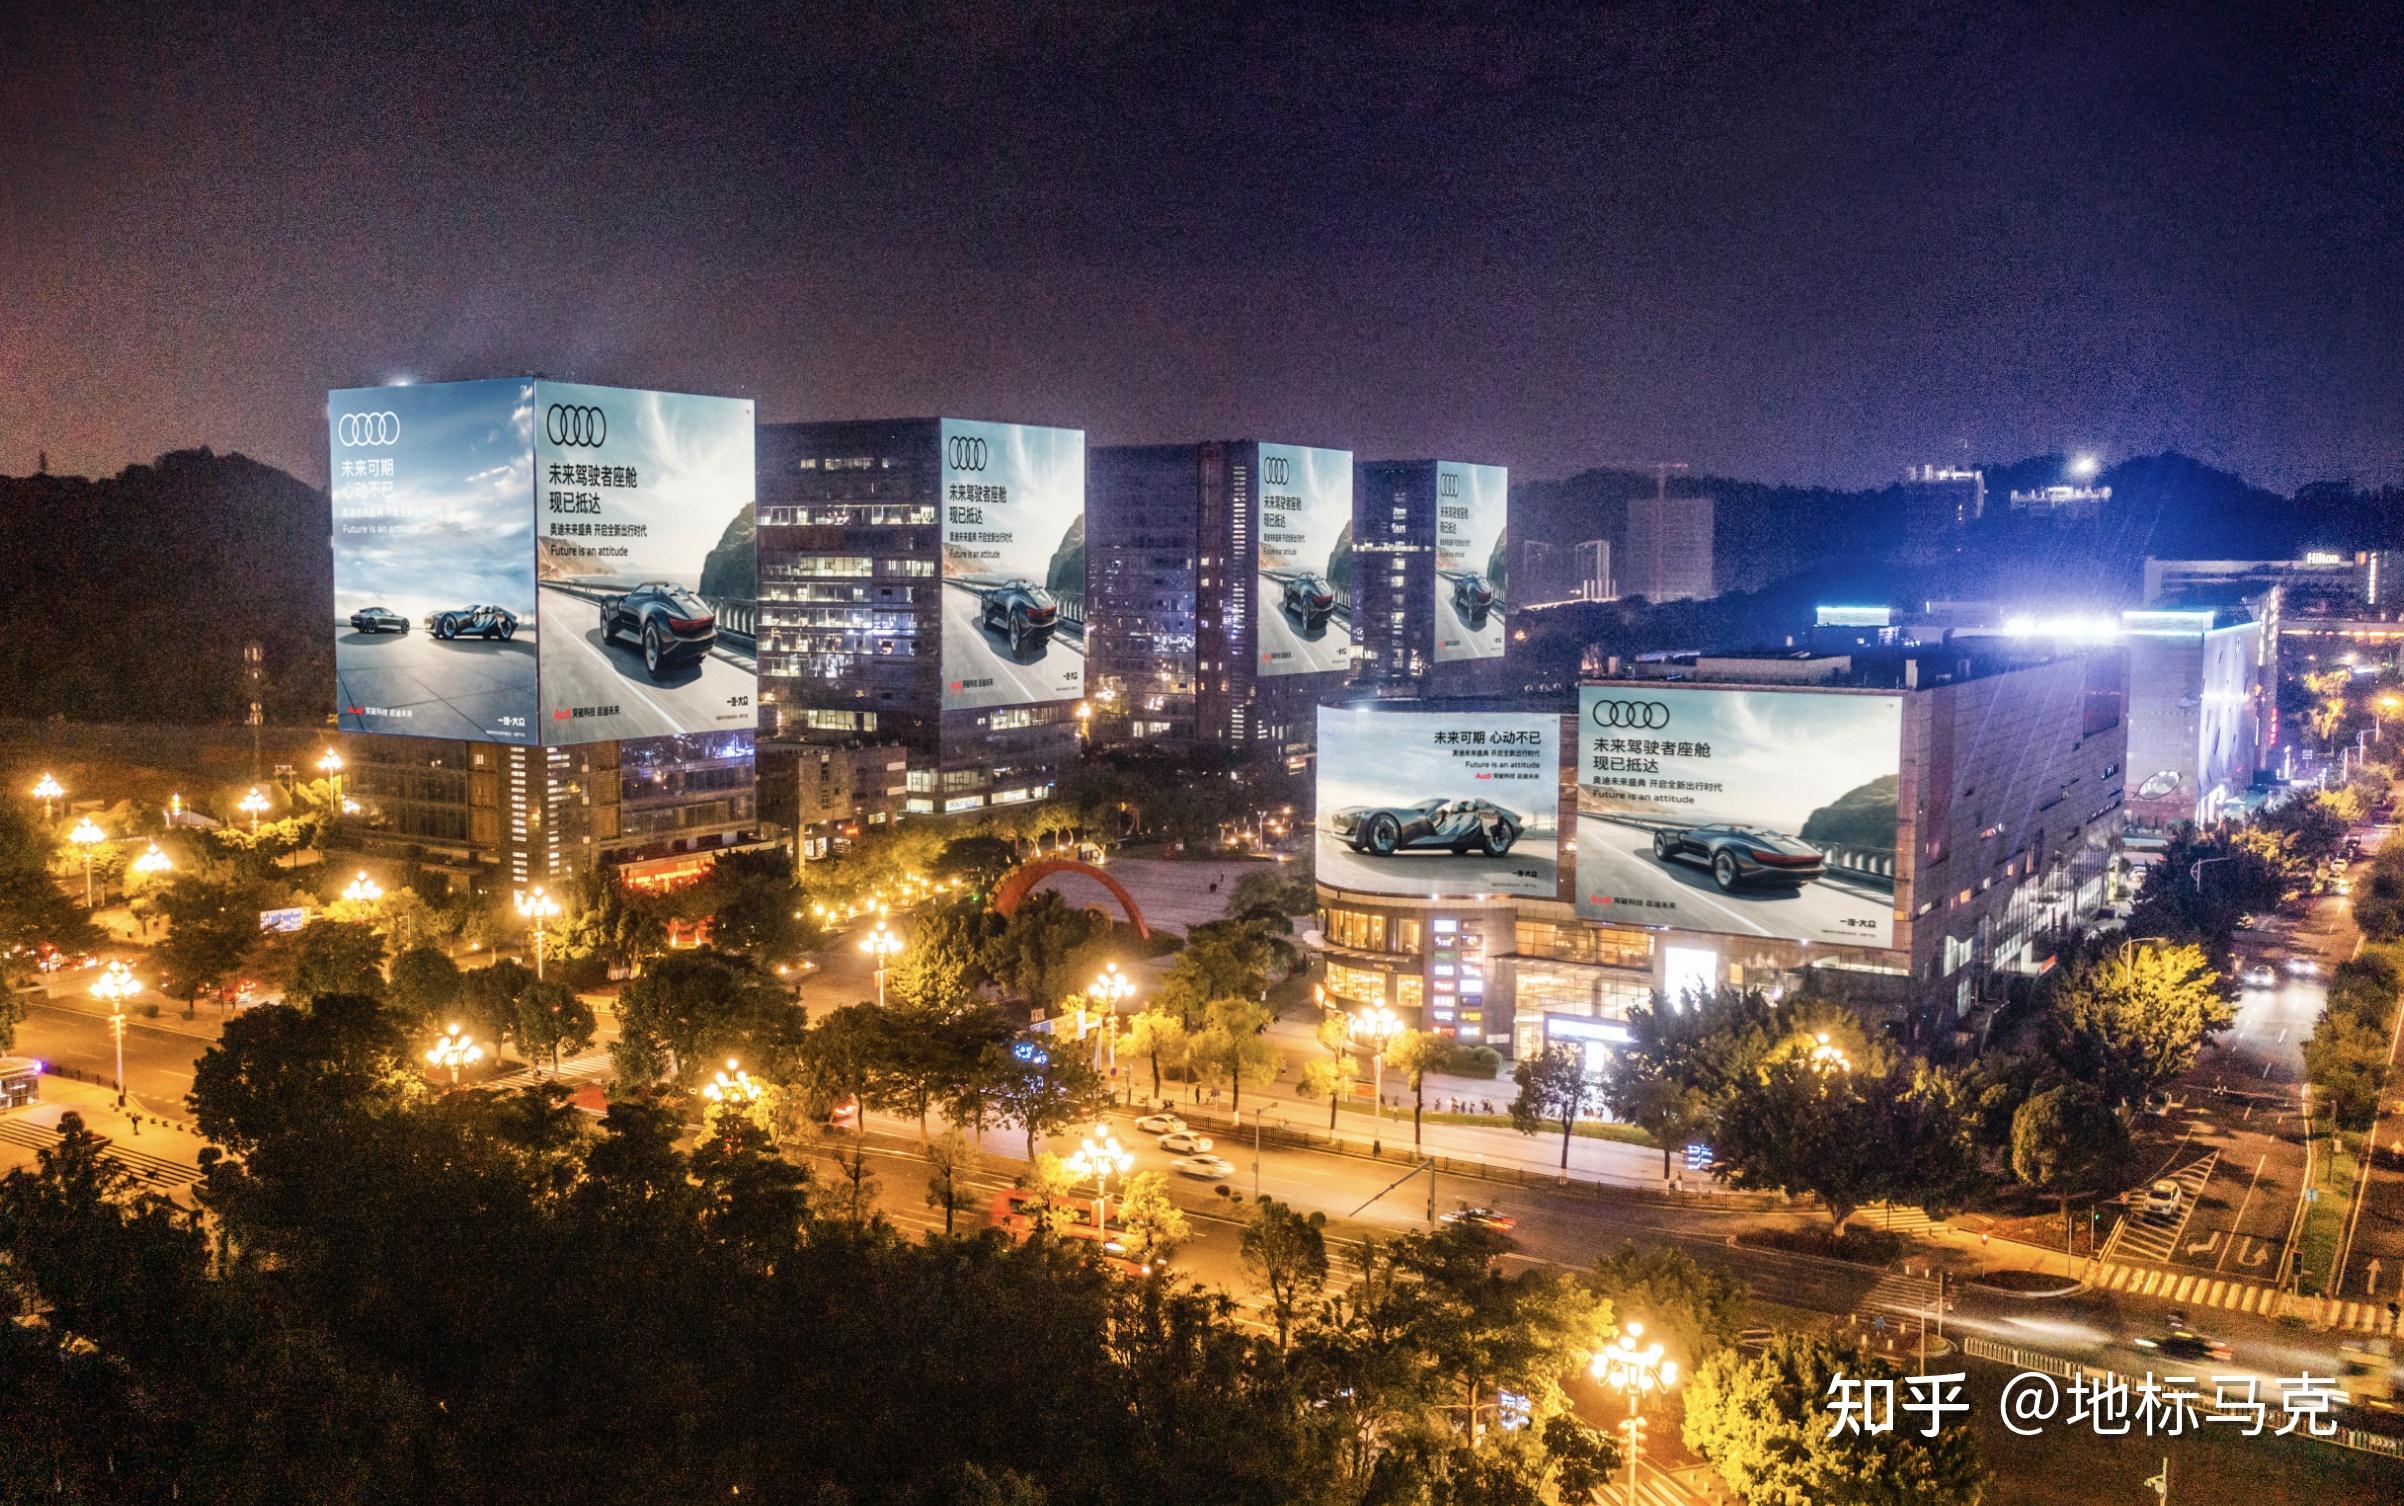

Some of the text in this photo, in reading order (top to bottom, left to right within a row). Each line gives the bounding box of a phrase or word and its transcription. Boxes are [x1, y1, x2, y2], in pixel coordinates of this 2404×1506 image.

[341, 458, 394, 477] 未来可期
[549, 462, 638, 488] 未来驾驶者座舱
[549, 491, 601, 514] 现已抵达
[550, 544, 628, 557] Future is an attitude
[2307, 552, 2340, 564] Hilton
[1434, 730, 1541, 745] 未来可期 心动不已
[1593, 737, 1711, 758] 未来驾驶者座舱
[1510, 761, 1541, 769] attitude
[1593, 755, 1659, 773] 现已抵达
[1649, 779, 1723, 792] 开启全新出行时代
[1593, 789, 1626, 800] Future
[1628, 792, 1636, 800] is
[1653, 794, 1695, 804] attitude
